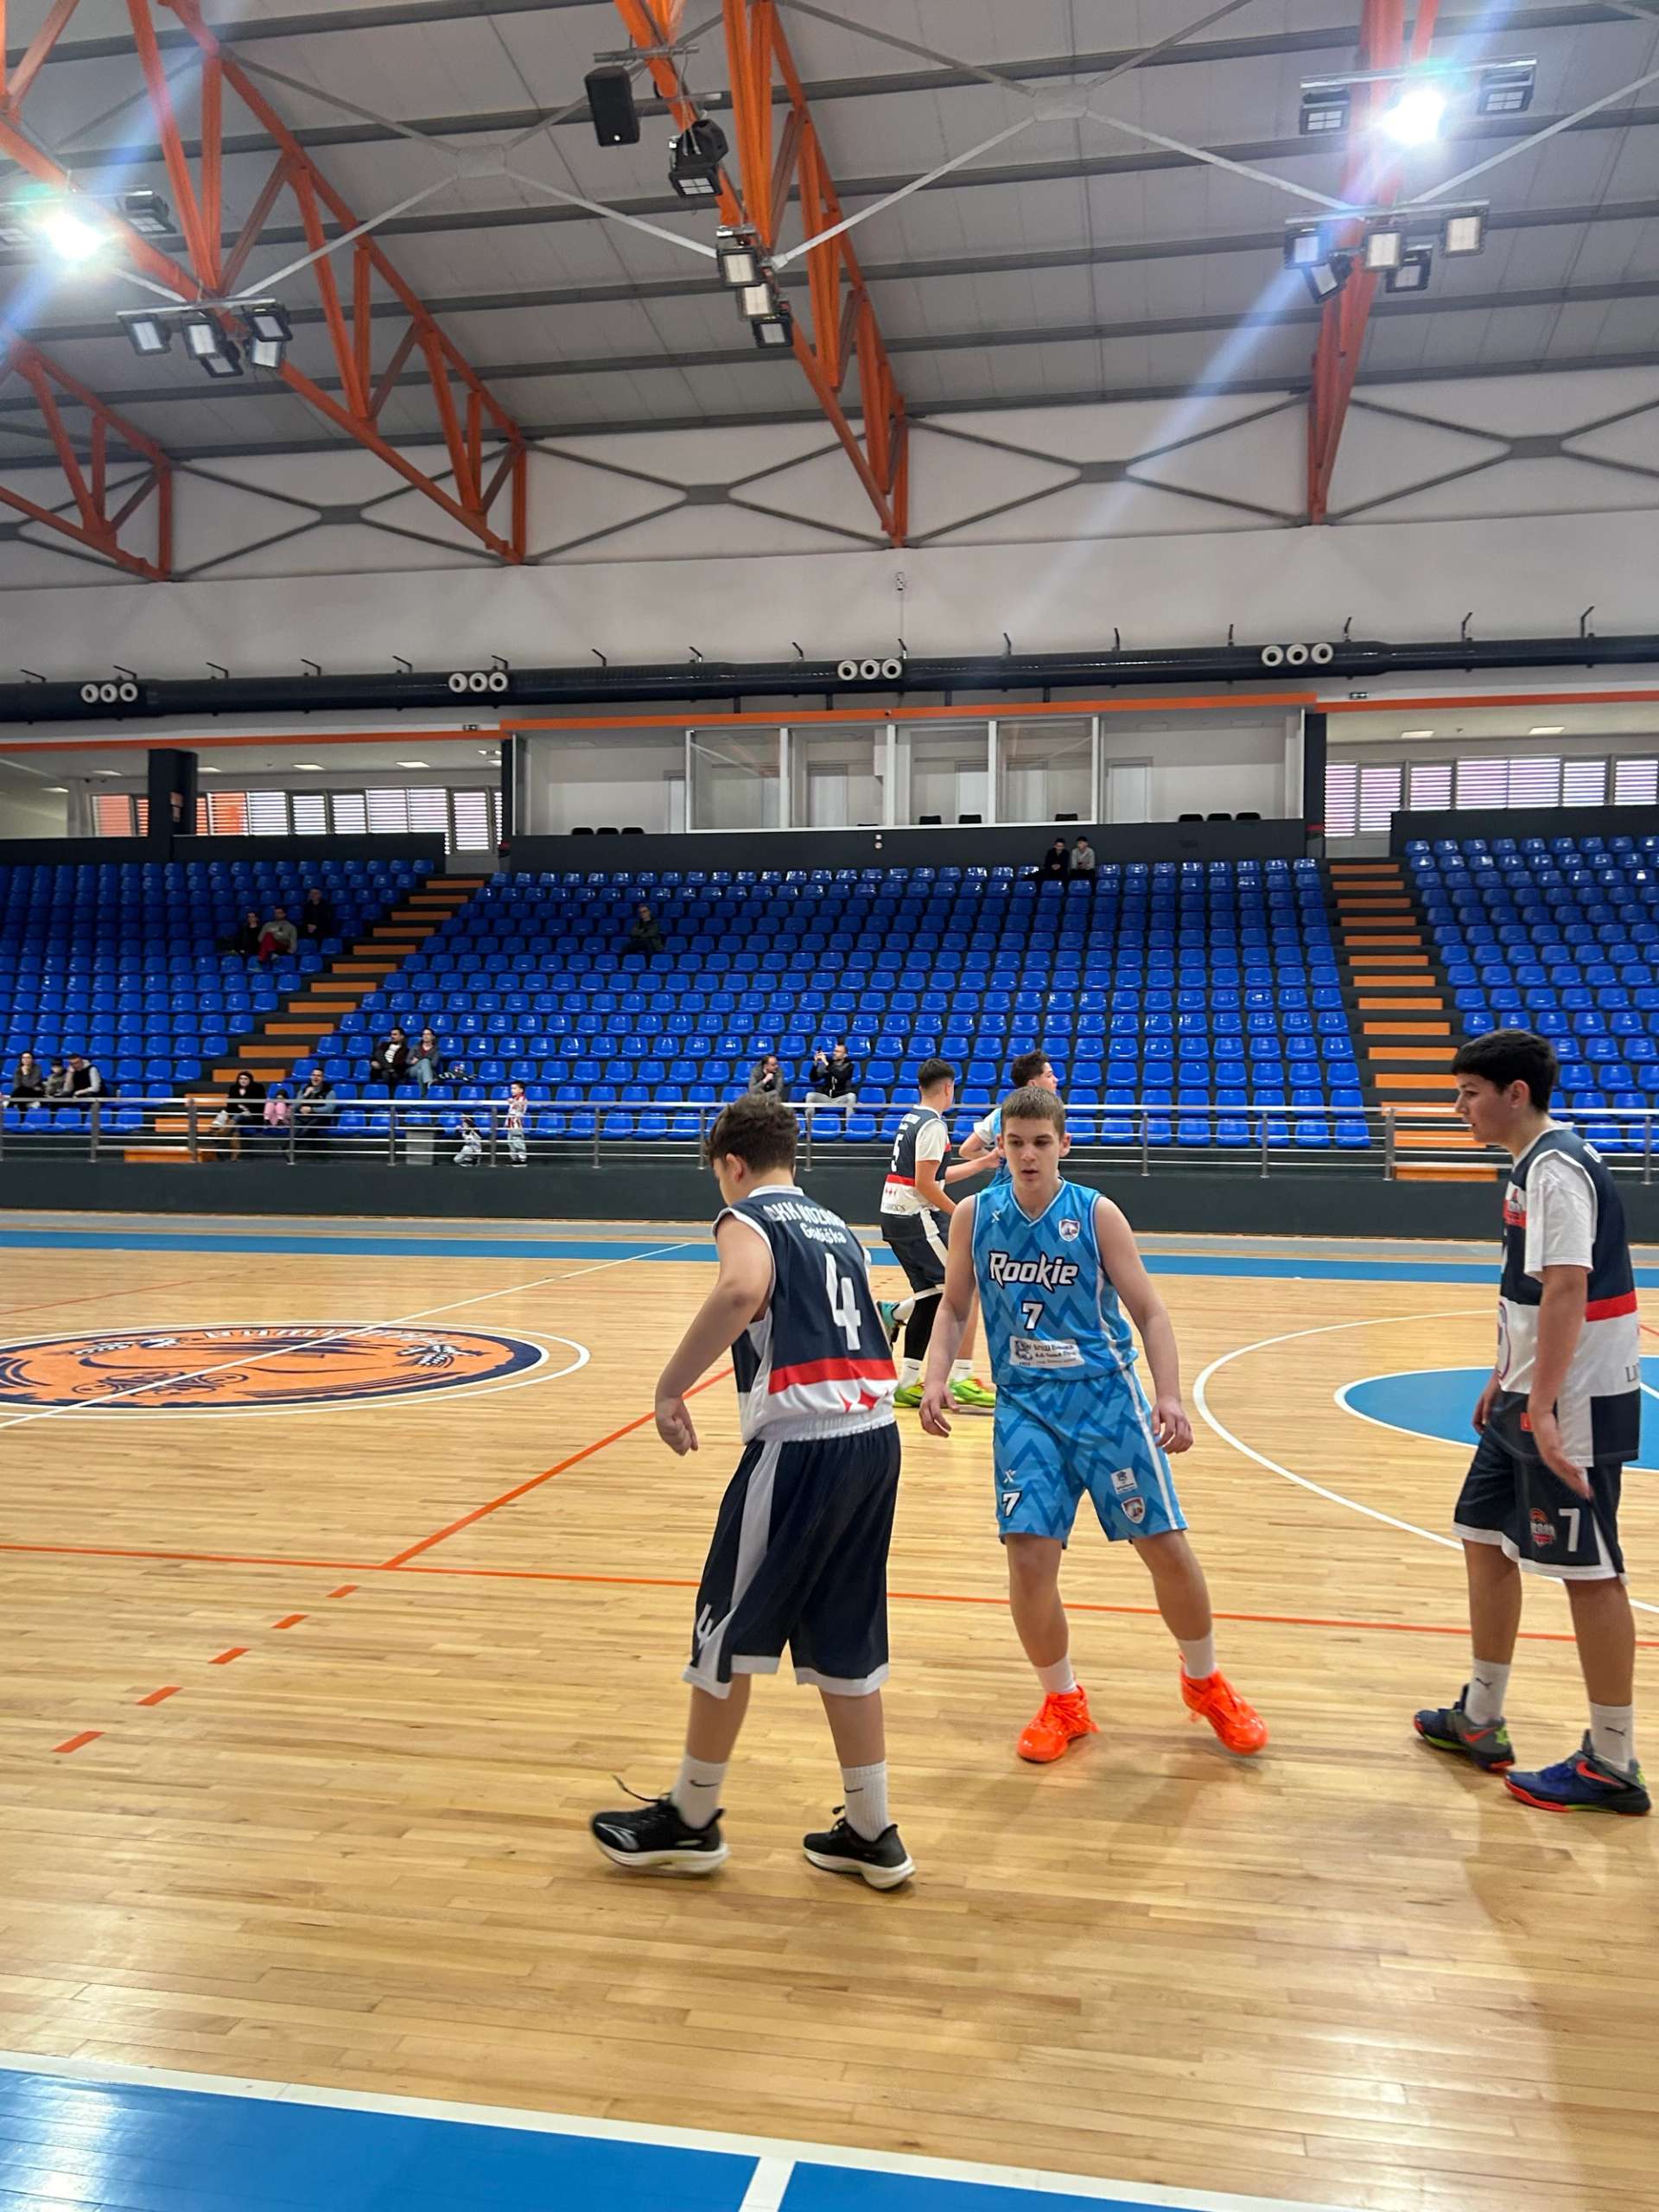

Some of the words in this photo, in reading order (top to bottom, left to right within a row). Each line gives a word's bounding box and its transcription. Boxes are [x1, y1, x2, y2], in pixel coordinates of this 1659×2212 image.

[988, 1251, 1078, 1293] Rookie
[824, 1253, 861, 1351] 4
[1021, 1301, 1044, 1331] 7
[1001, 1490, 1023, 1518] 7
[1558, 1508, 1580, 1552] 7
[696, 1604, 713, 1649] 4
